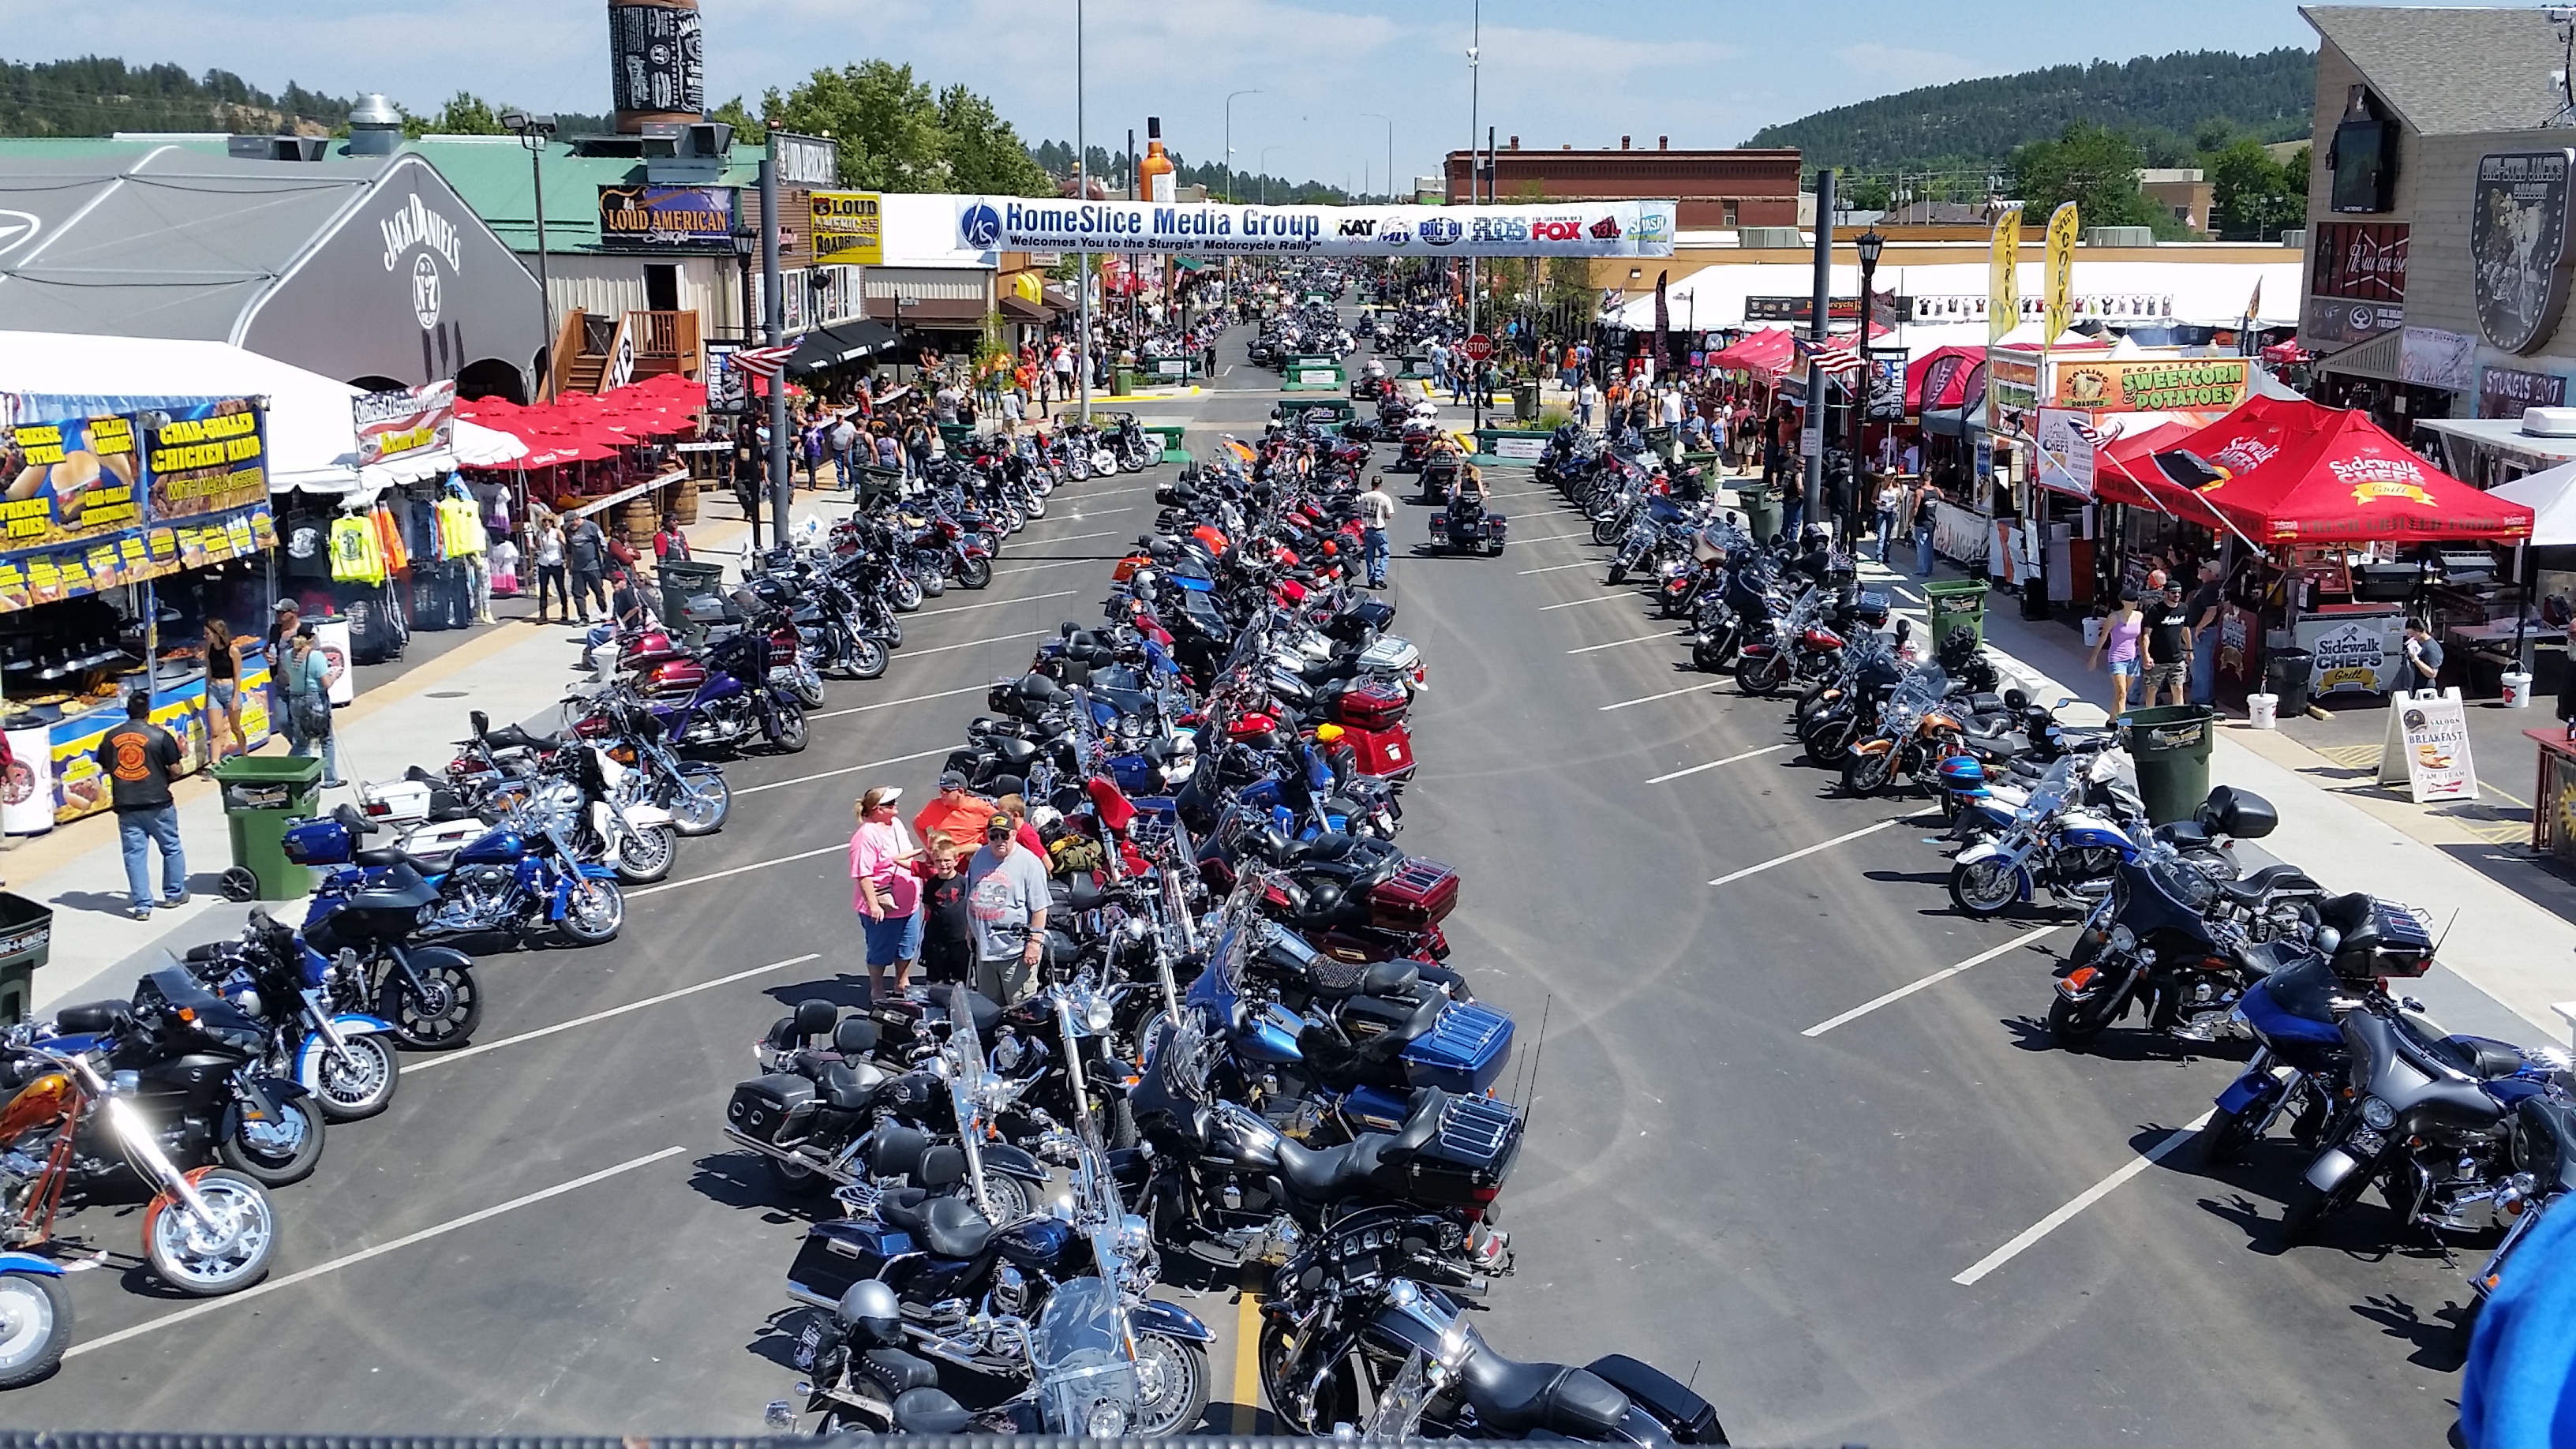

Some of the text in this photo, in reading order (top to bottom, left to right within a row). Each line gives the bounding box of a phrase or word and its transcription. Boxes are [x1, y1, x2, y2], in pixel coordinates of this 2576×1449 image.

[832, 200, 878, 216] LOUD
[608, 209, 727, 232] LOUD AMERICAN
[814, 216, 879, 234] AMERICAN
[1006, 202, 1320, 242] HomeSlice Media Group
[380, 207, 414, 271] JACK
[643, 226, 690, 246] Sturgis
[1532, 222, 1582, 242] FOX
[1009, 236, 1076, 248] Welcomes
[1080, 238, 1105, 249] You
[1106, 238, 1121, 249] to
[1123, 238, 1145, 249] the
[1204, 240, 1275, 251] Motorcycle
[2057, 231, 2070, 306] CORN
[1467, 342, 1491, 354] STOP
[2065, 368, 2110, 385] ROLLING
[2122, 361, 2212, 375] ROASTED
[710, 354, 723, 410] STURGIS
[2121, 365, 2243, 392] SWEETCORN
[2486, 370, 2532, 399] STURGIS
[1889, 361, 1905, 419] STURGIS
[2122, 385, 2235, 412] & POTATOES
[2071, 399, 2105, 408] ROASTER
[14, 426, 63, 447] CHEESE
[159, 412, 256, 445] CHAR-GRILLED
[24, 444, 66, 466] STEAK
[2042, 438, 2069, 454] CHEFS
[151, 443, 226, 474] CHICKEN
[2328, 455, 2421, 475] Sidewalk
[2337, 469, 2426, 487] CHEFS
[167, 479, 198, 502] WITH
[2372, 484, 2408, 494] Grill
[0, 497, 51, 521] FRENCH
[7, 516, 46, 539] FRIES
[2319, 638, 2380, 655] Sidewalk
[2316, 653, 2383, 670] CHEFS
[2334, 669, 2363, 681] Grill
[2409, 731, 2463, 744] BREAKFAST
